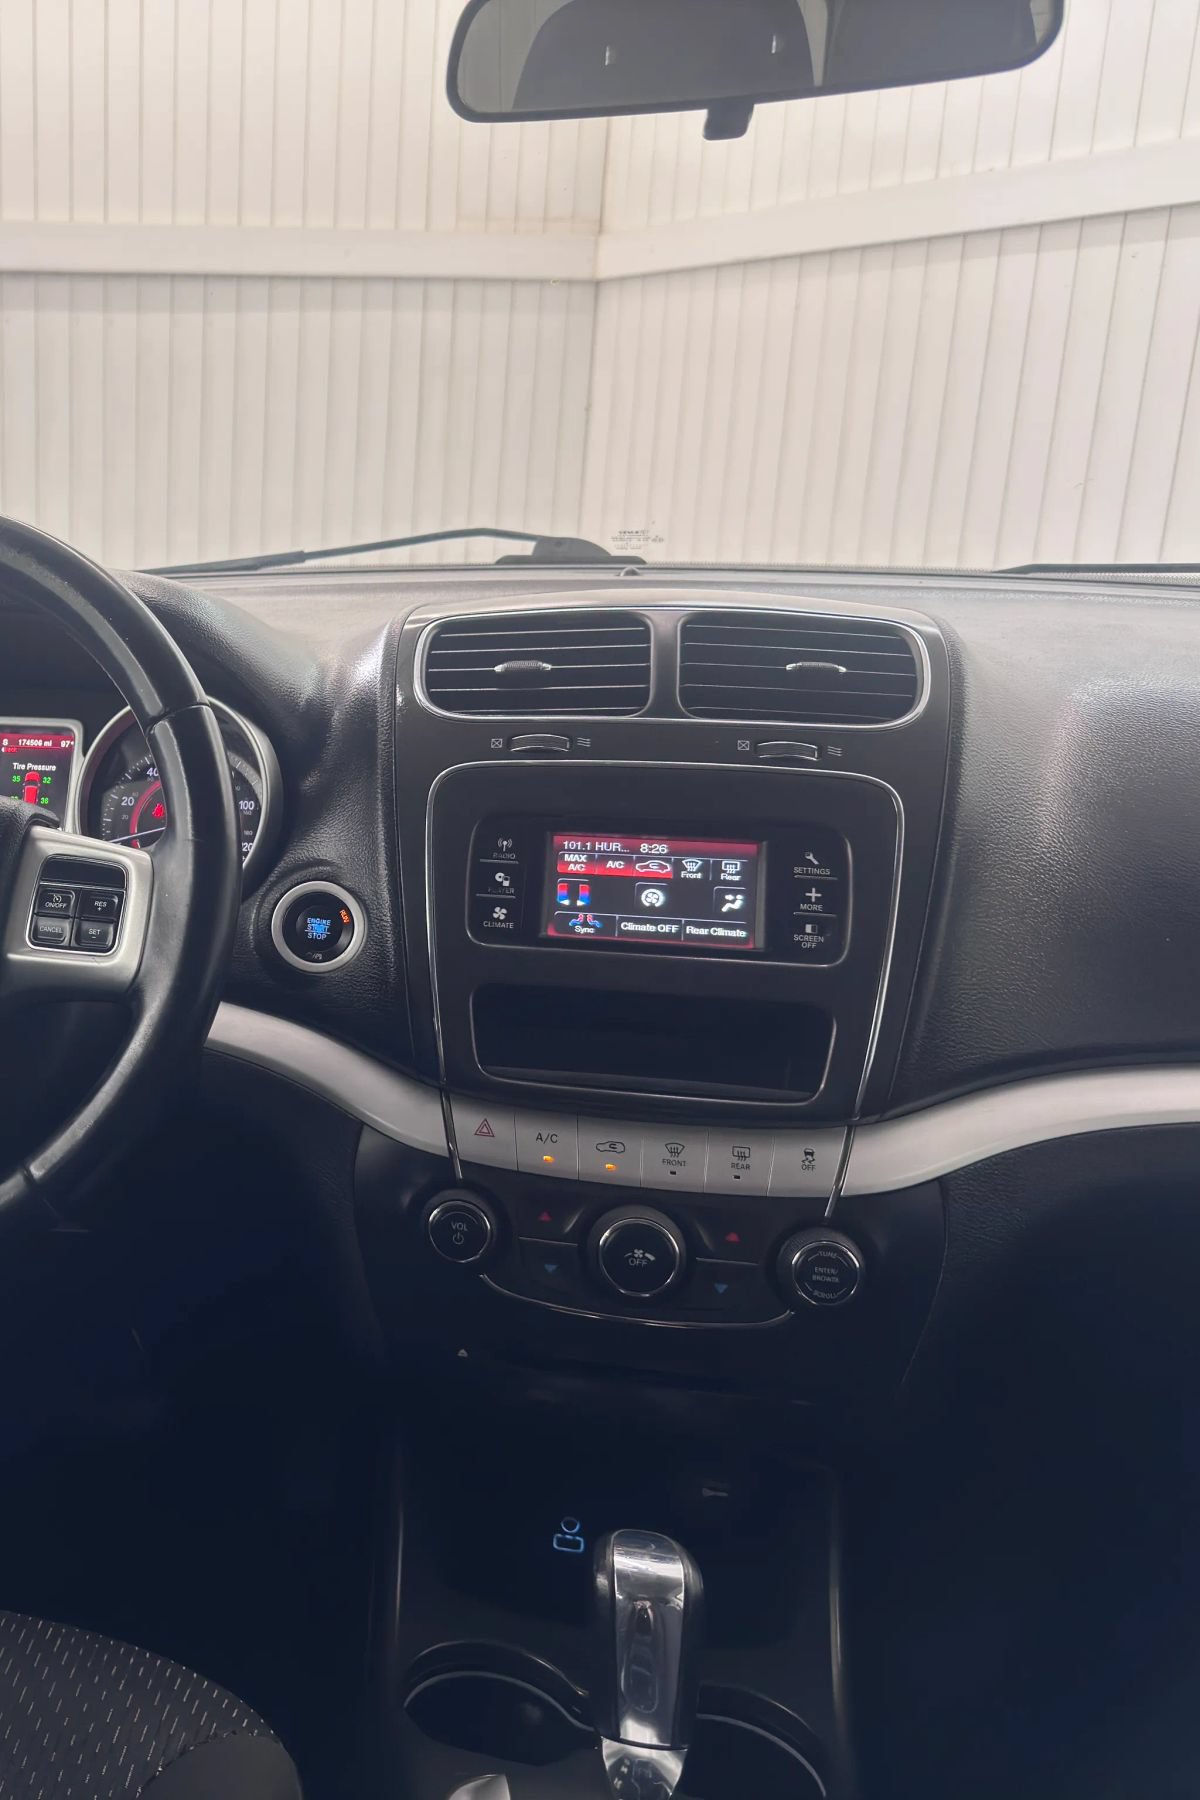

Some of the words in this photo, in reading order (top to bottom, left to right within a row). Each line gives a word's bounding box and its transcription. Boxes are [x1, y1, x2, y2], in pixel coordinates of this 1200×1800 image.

[12, 762, 26, 770] Tire
[26, 763, 57, 771] Pressure
[146, 767, 159, 777] 40
[12, 775, 21, 783] 35
[42, 776, 52, 784] 32
[121, 796, 135, 807] 20
[239, 800, 255, 811] 100
[563, 841, 591, 851] 101.1
[595, 842, 630, 853] HUR...
[640, 843, 668, 854] 8:26
[493, 852, 516, 860] RADIO
[564, 853, 587, 863] MAX
[568, 863, 586, 872] A/C
[606, 860, 625, 870] A/C
[681, 871, 702, 880] Front
[793, 867, 831, 876] SETTINGS
[720, 873, 741, 882] Rear
[800, 904, 823, 912] MORE
[307, 917, 331, 926] ENGINE
[483, 921, 514, 929] CLIMATE
[574, 925, 595, 935] Sync
[621, 922, 656, 932] Climate
[657, 924, 679, 934] OFF
[686, 926, 708, 936] Rear
[710, 927, 746, 938] Climate
[307, 932, 327, 940] STOP
[793, 934, 824, 943] SCREEN
[535, 1132, 558, 1144] A/C
[662, 1158, 686, 1167] FRONT
[731, 1162, 751, 1171] REAR
[450, 1221, 468, 1231] VOL
[628, 1257, 648, 1268] OFF
